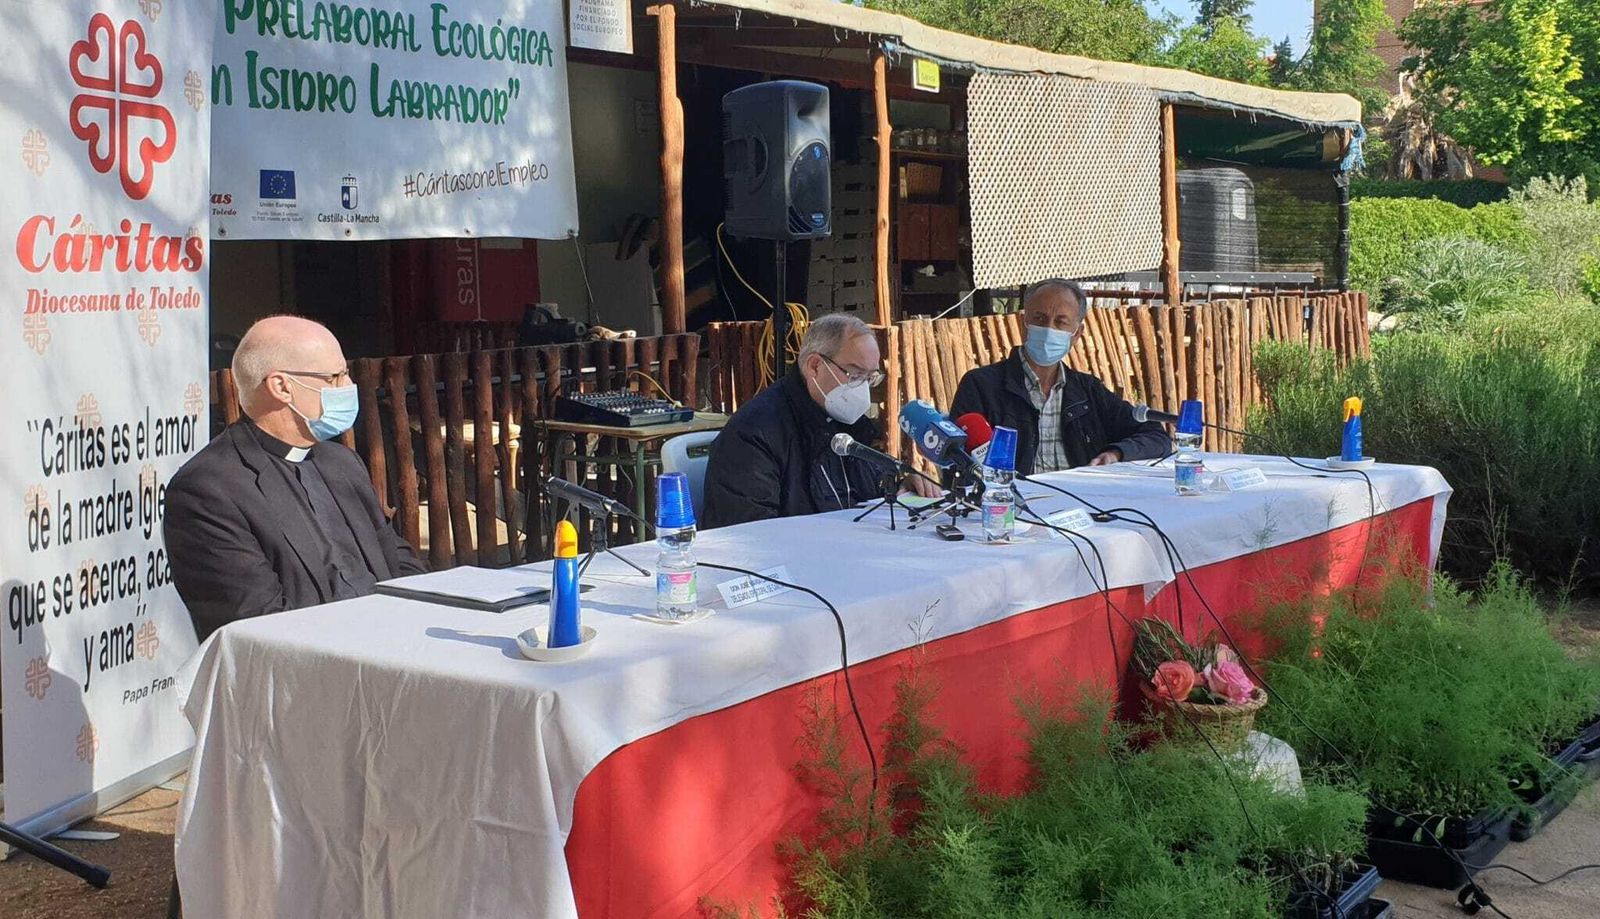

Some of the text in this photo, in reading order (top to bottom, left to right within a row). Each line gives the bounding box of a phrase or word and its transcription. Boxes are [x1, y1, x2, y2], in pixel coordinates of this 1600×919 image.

[224, 0, 554, 67] PRELABORAL ECOLÓGICA
[245, 50, 357, 114] ISIDRO
[209, 192, 233, 205] as
[402, 159, 549, 199] #CáritasconelEmpleo
[212, 208, 237, 216] Toledo
[16, 213, 204, 273] Cáritas
[24, 286, 201, 314] Diocesana de Toledo
[111, 422, 131, 465] es
[136, 405, 150, 461] el
[154, 414, 198, 457] amor
[975, 445, 989, 457] eur
[28, 493, 51, 553] de
[57, 489, 72, 546] la
[79, 478, 133, 541] madre
[8, 580, 47, 645] que
[52, 571, 73, 618] se
[79, 553, 142, 610] acerca,
[84, 634, 95, 693] y
[122, 686, 149, 705] Papa
